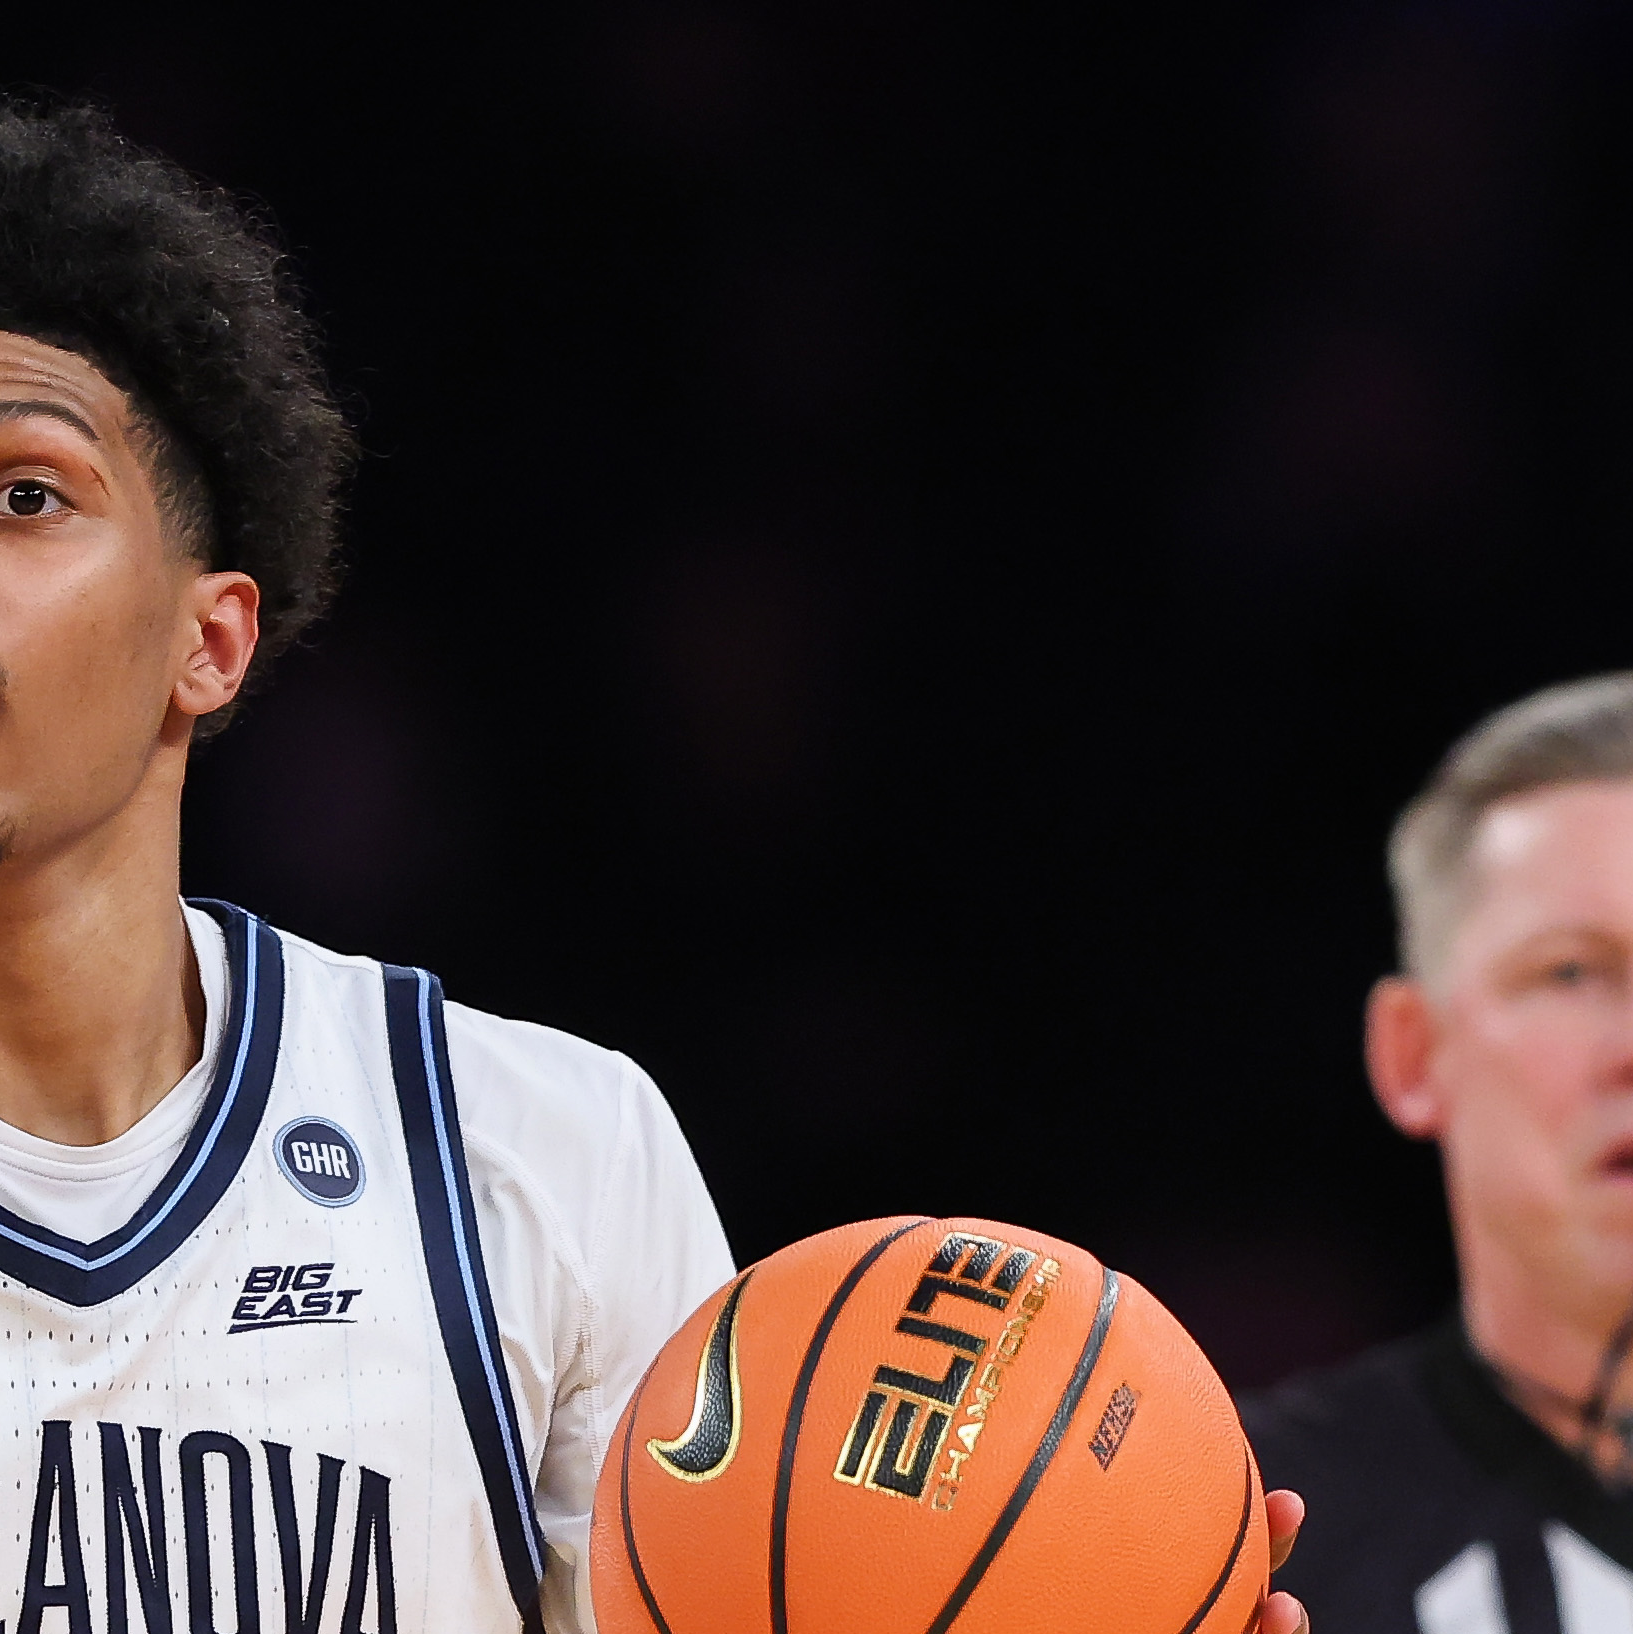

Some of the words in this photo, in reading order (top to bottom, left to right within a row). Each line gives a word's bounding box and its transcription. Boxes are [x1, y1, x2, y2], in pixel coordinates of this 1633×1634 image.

[291, 1141, 352, 1180] GHR
[241, 1263, 335, 1294] BIG
[231, 1289, 363, 1321] EAST
[833, 1231, 1038, 1502] ELITE
